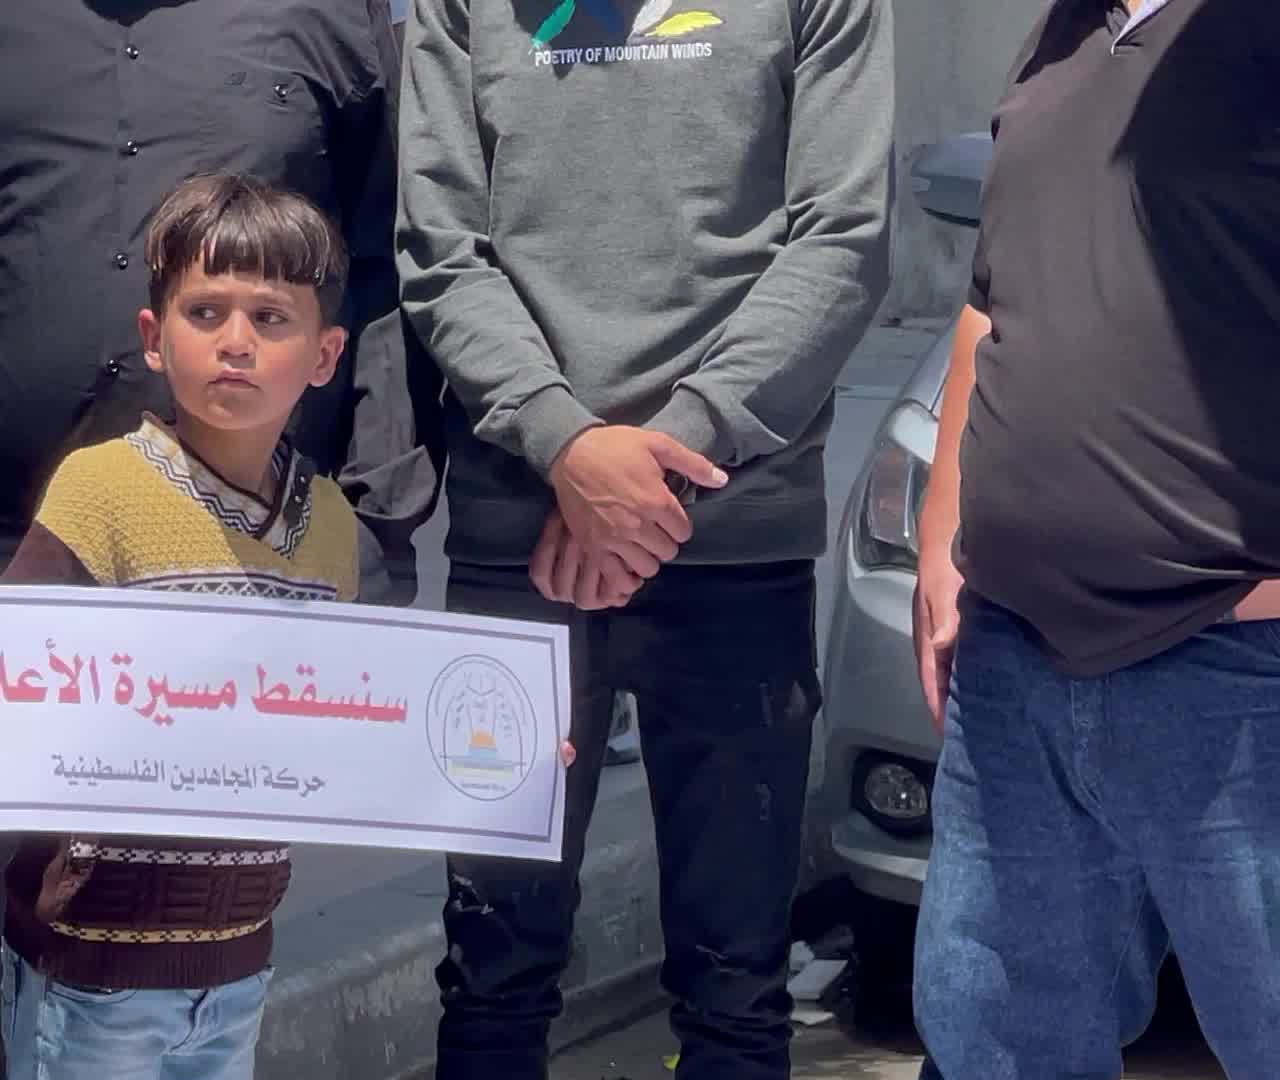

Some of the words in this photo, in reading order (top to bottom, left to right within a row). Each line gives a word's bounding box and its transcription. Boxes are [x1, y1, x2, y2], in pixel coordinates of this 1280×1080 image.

[535, 49, 583, 66] POETRY
[585, 47, 601, 63] OF
[604, 43, 669, 62] MOUNTAIN
[671, 42, 712, 59] WINDS
[110, 651, 238, 727] مسيرة
[251, 663, 408, 724] سنسقط
[51, 753, 167, 786] الفلسطينية
[170, 764, 257, 797] المجاهدين
[261, 764, 326, 798] حركة
